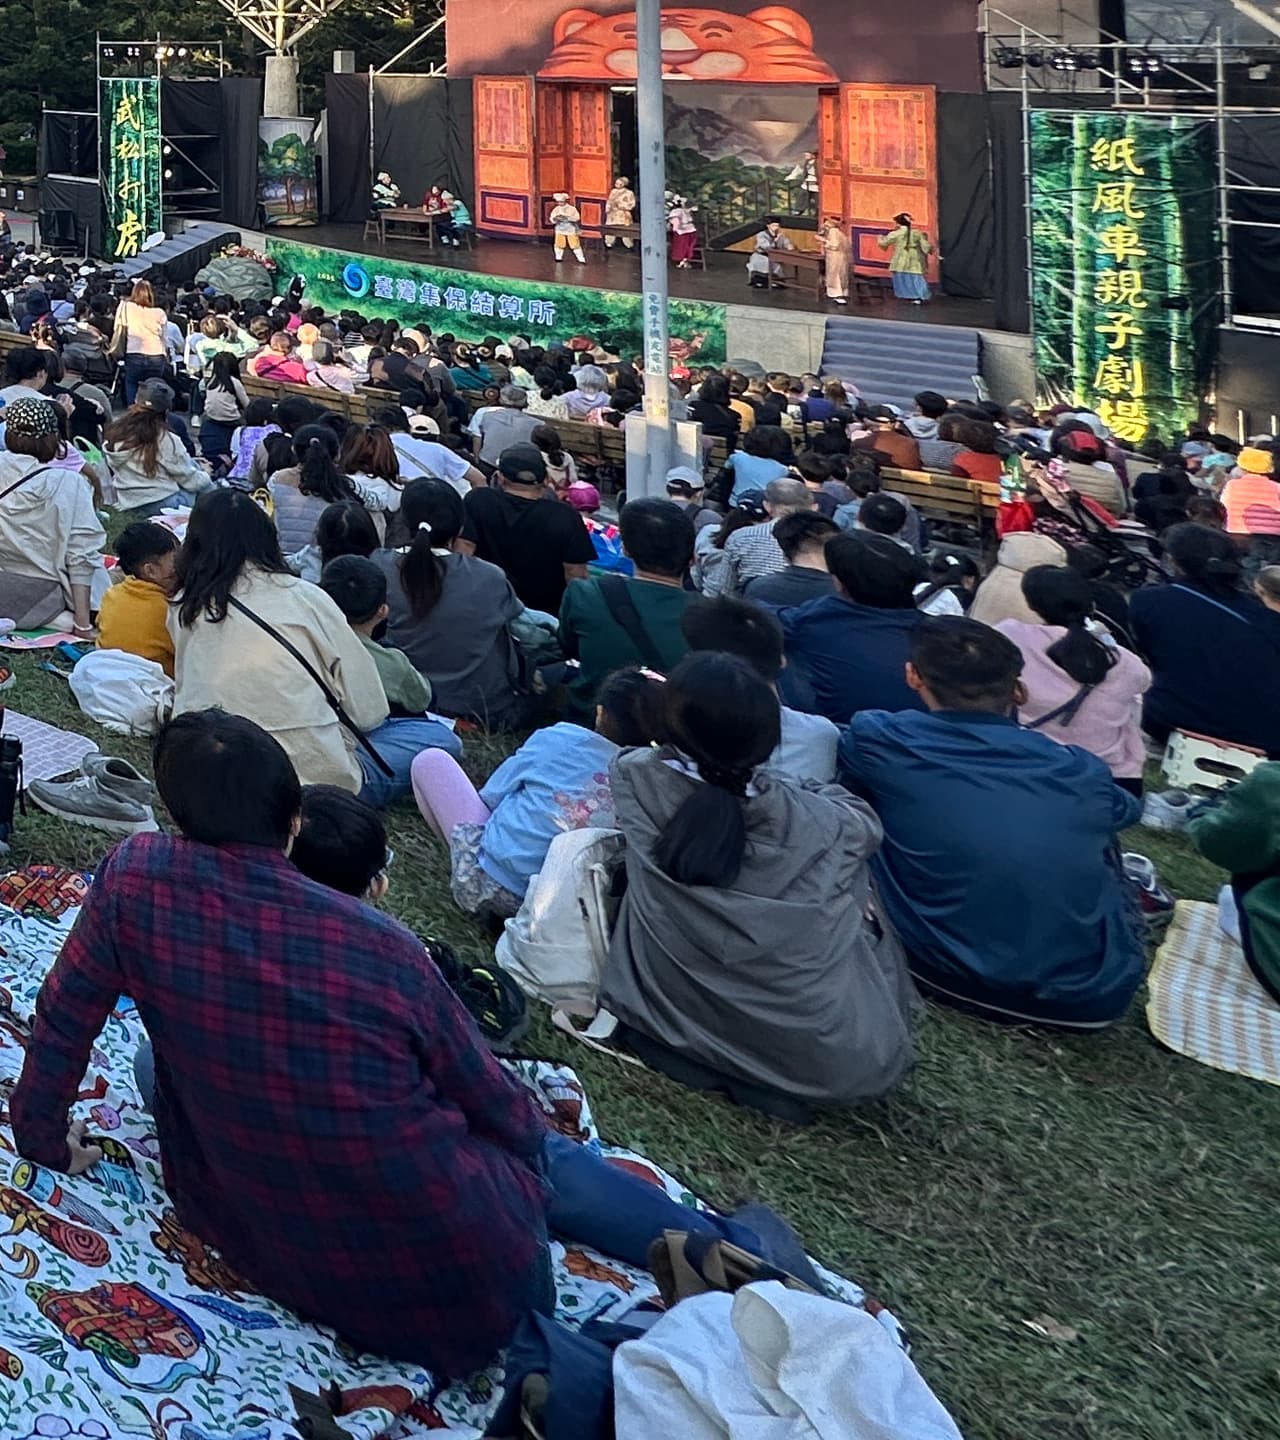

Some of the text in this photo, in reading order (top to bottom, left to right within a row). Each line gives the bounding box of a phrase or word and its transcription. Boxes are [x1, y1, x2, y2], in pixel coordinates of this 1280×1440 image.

[115, 95, 143, 257] 武松打虎
[374, 275, 556, 326] 臺灣集保結算所
[1089, 137, 1150, 442] 紙風車親子劇場
